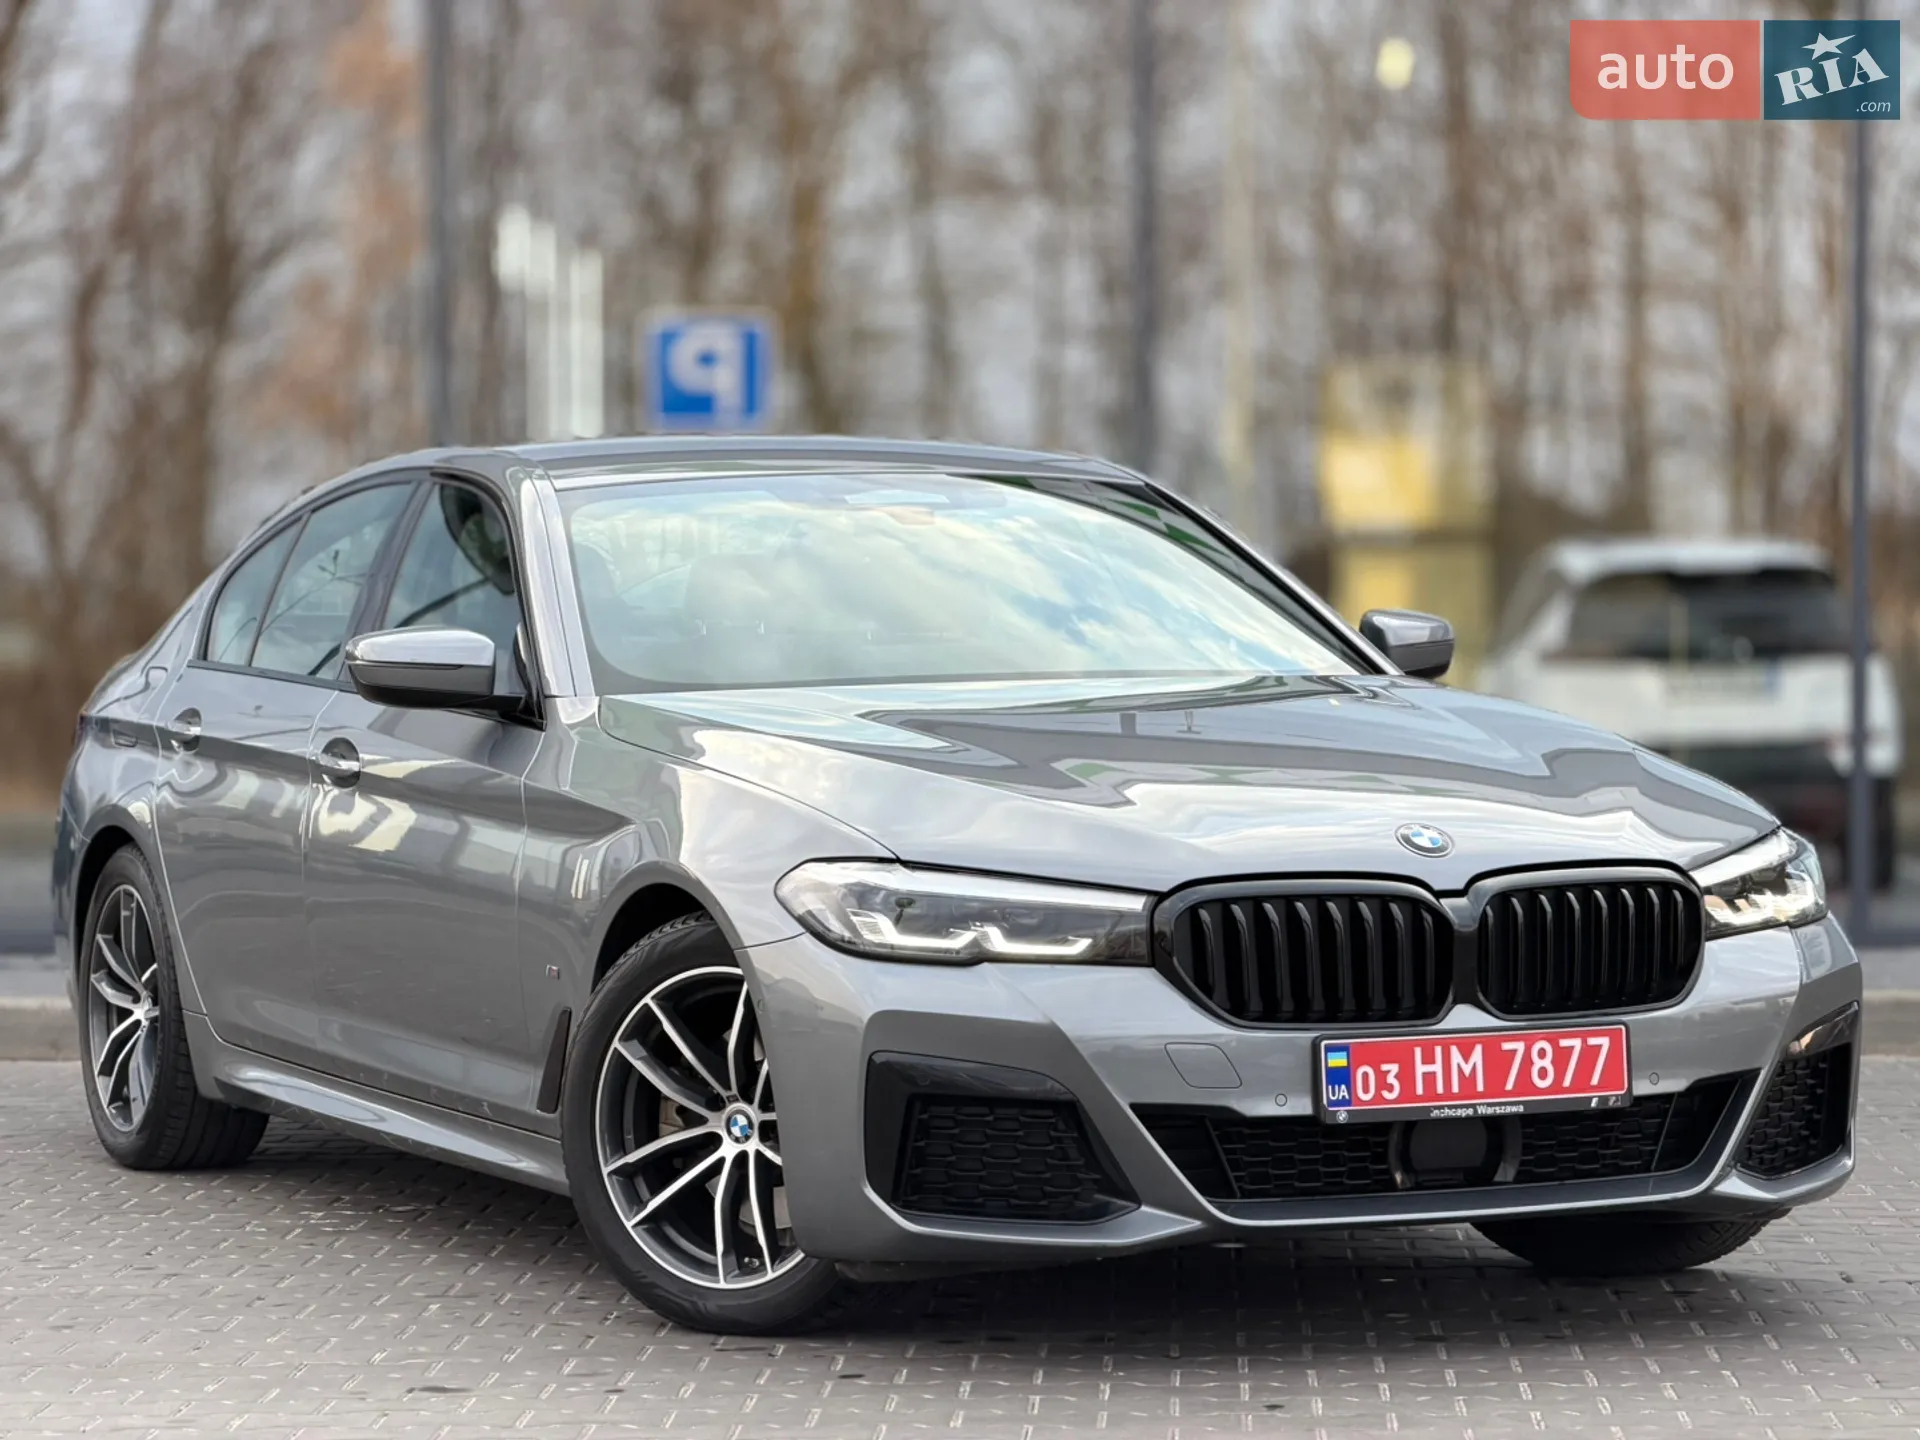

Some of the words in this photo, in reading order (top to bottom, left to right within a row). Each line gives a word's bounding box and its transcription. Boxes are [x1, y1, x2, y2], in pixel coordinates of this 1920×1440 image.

[1355, 1063, 1400, 1101] 03
[1414, 1044, 1484, 1096] HM
[1501, 1036, 1610, 1091] 7877
[1328, 1084, 1349, 1100] UA
[1476, 1103, 1524, 1115] Warszawa
